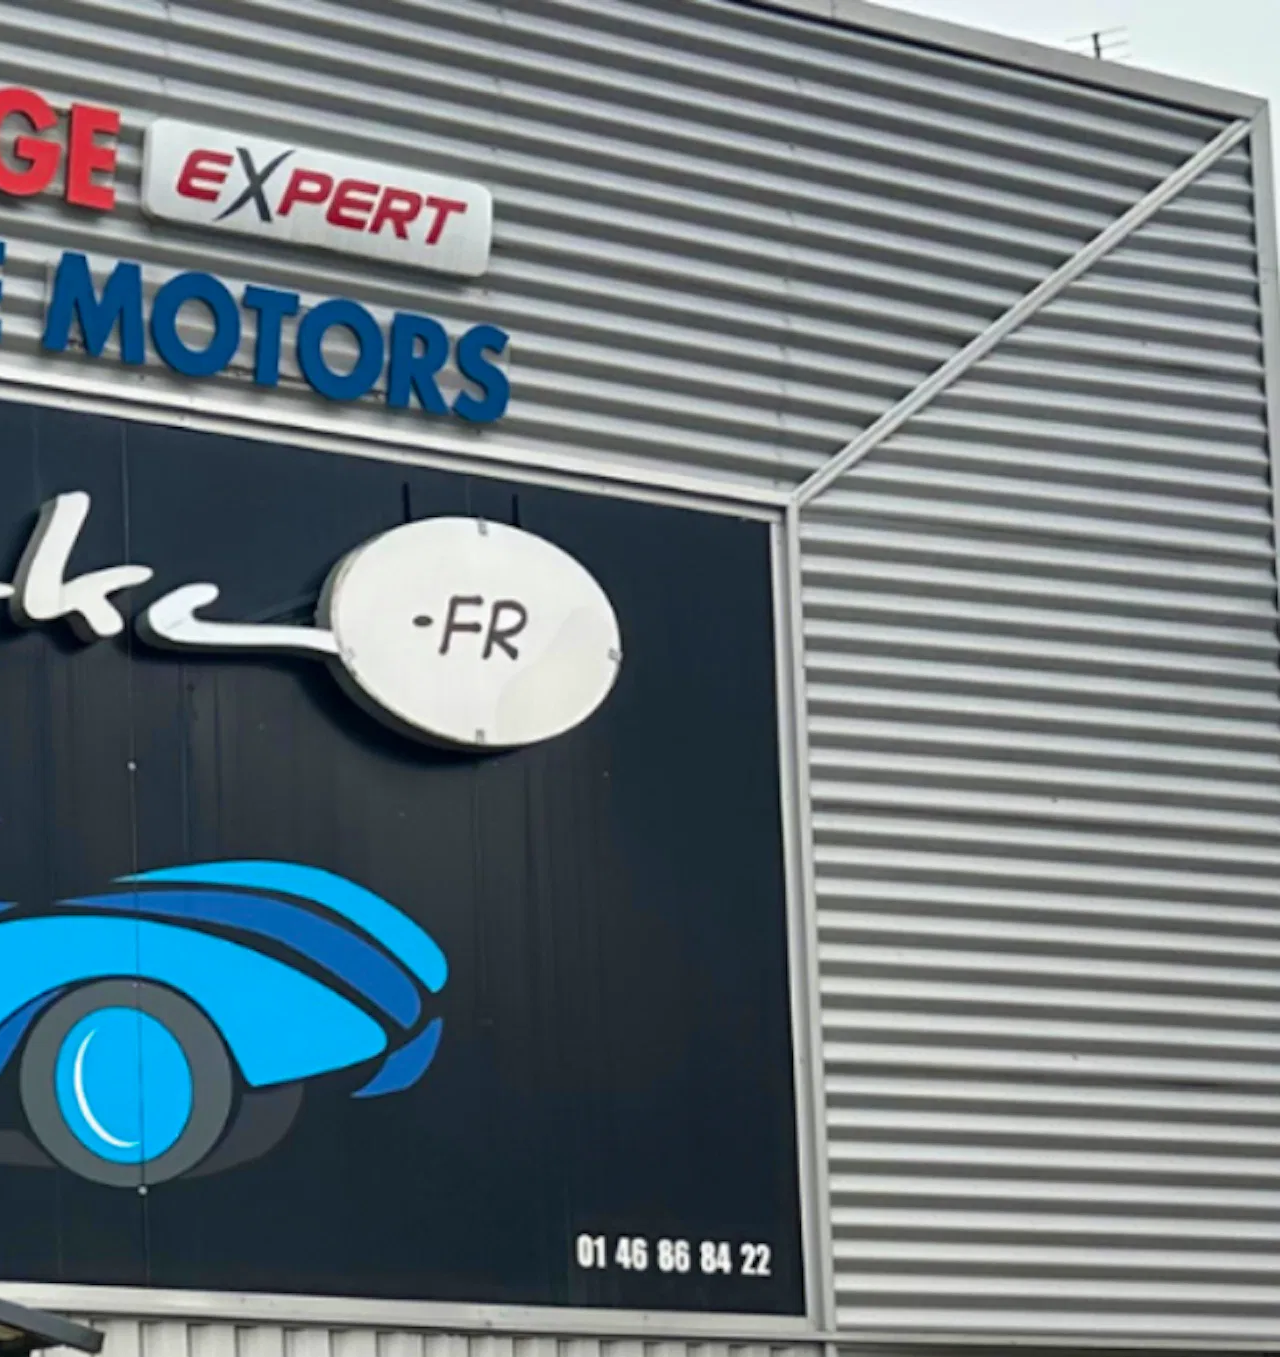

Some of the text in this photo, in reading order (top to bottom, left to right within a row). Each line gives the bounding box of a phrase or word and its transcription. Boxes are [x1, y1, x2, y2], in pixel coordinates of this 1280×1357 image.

[42, 250, 512, 424] MOTORS
[576, 1233, 772, 1276] 01 46 86 84 22
